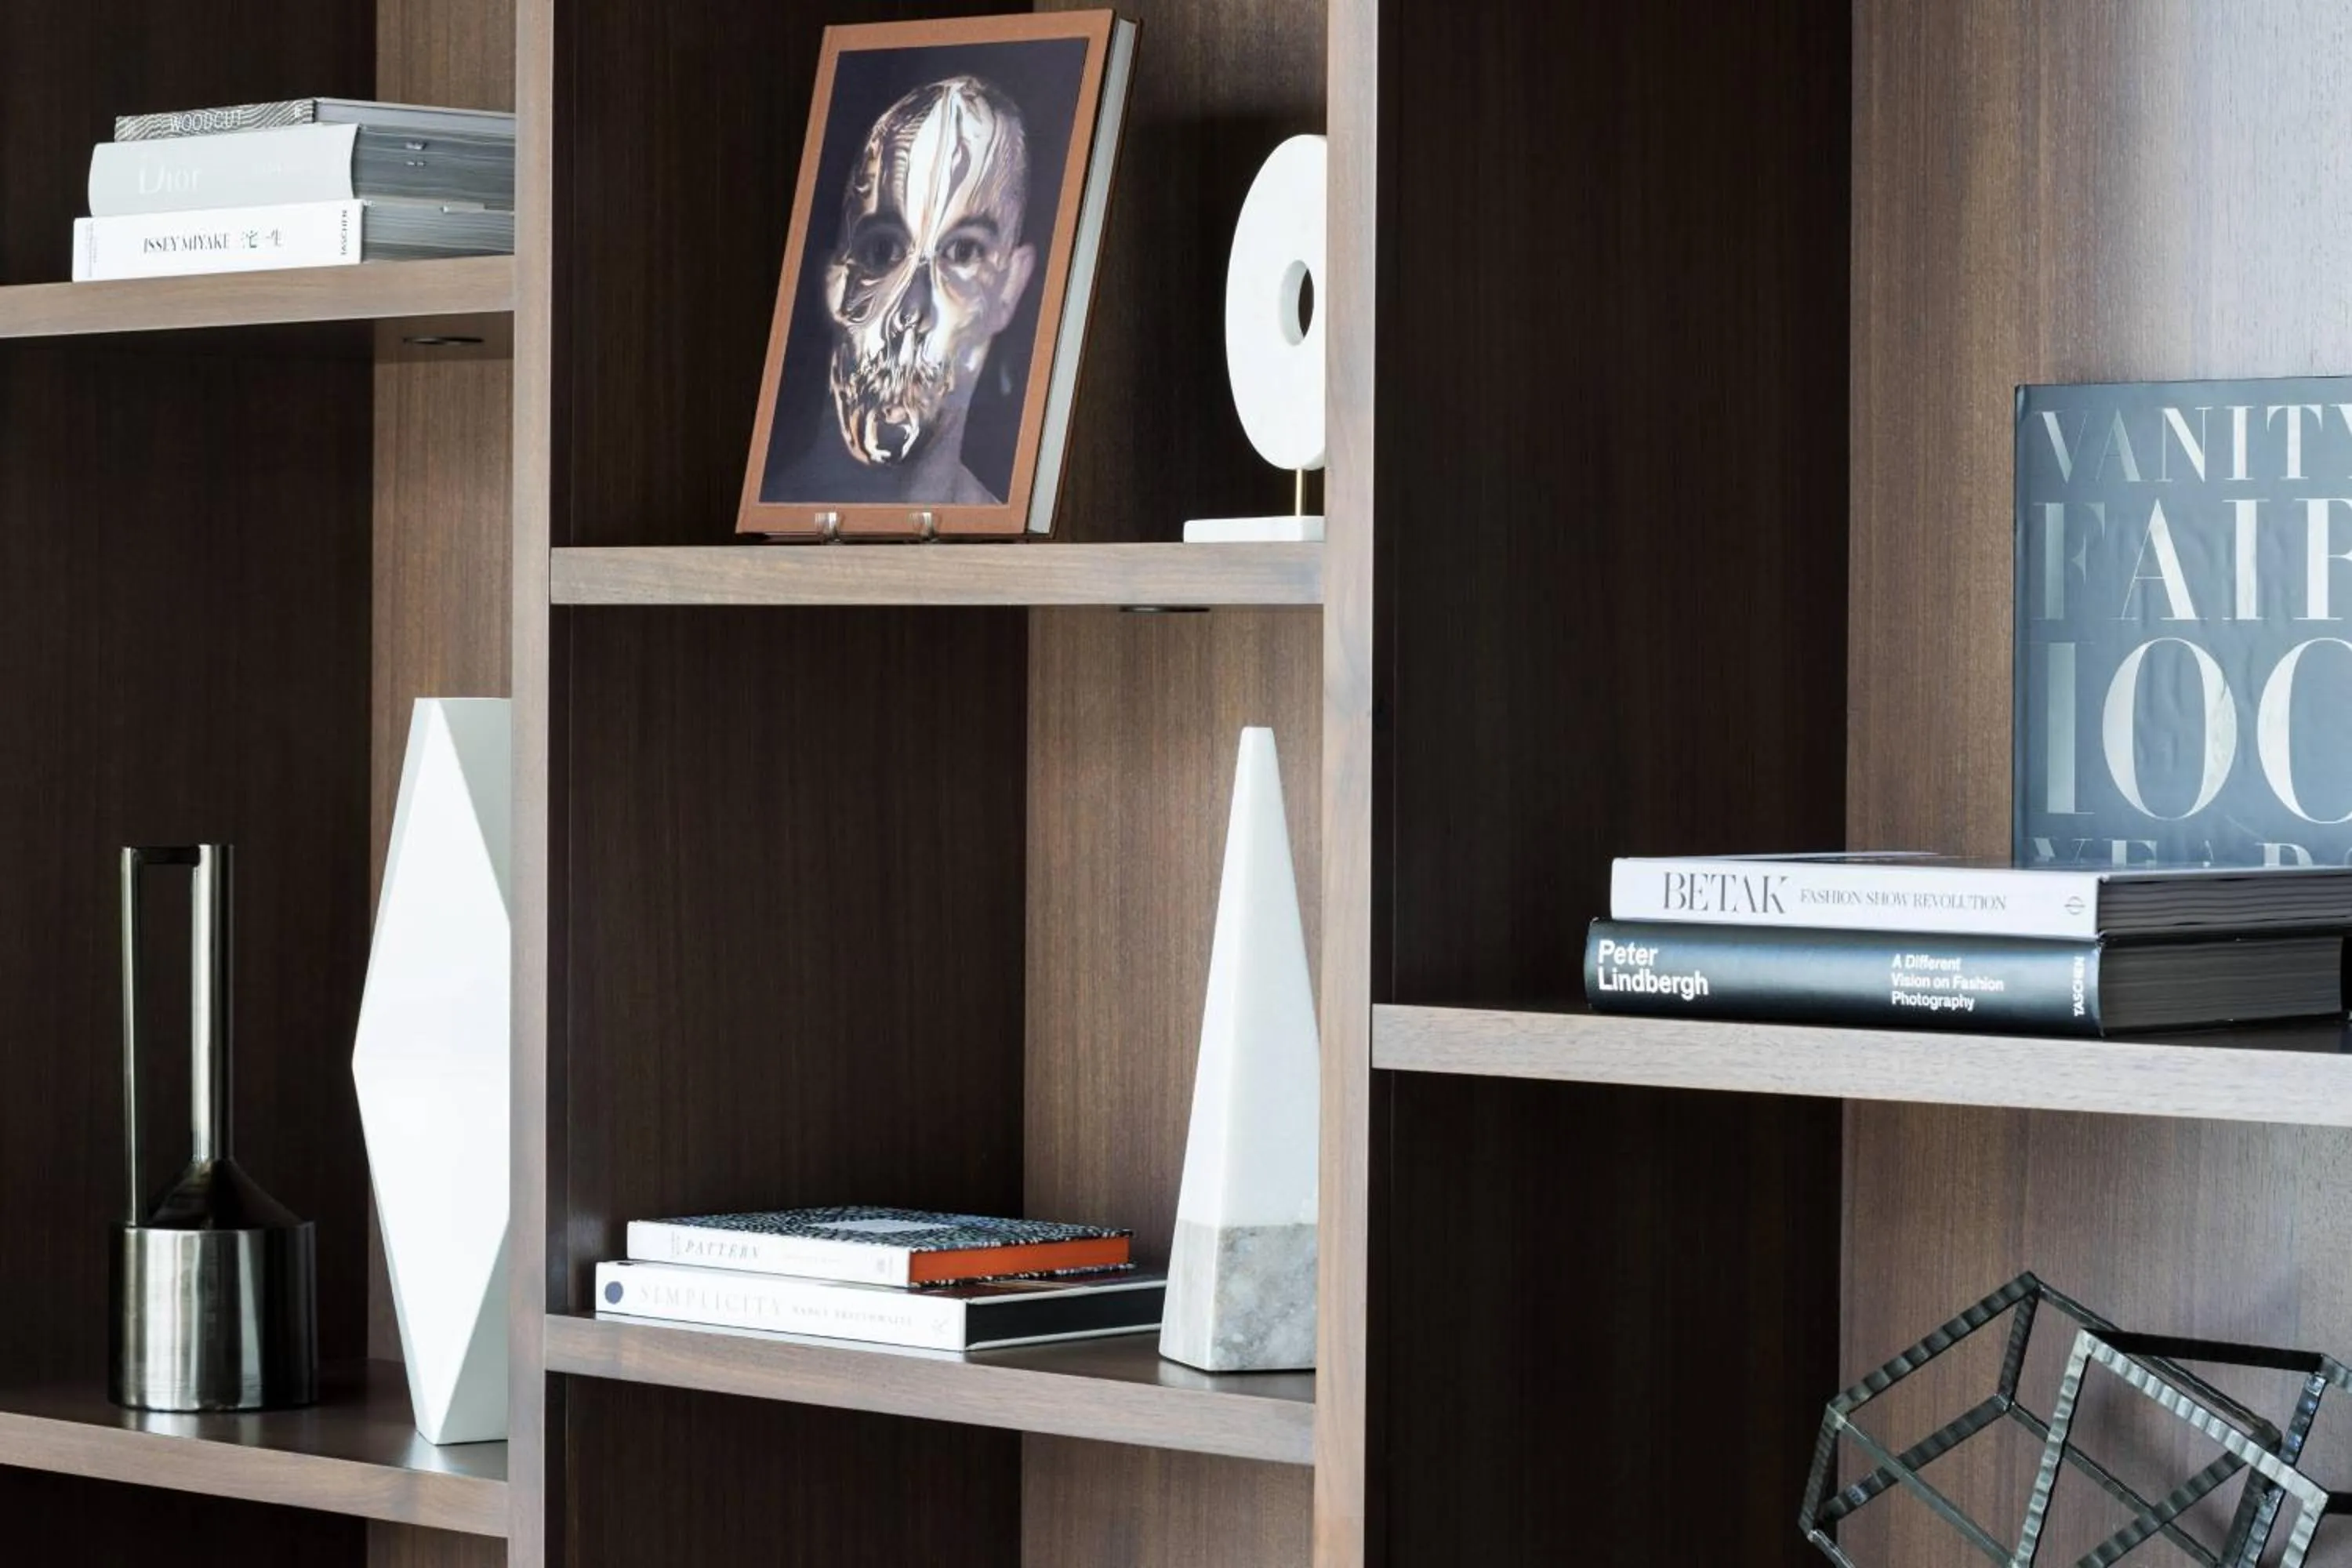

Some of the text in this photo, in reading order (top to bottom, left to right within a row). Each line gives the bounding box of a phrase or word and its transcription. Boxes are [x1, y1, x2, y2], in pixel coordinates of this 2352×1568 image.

[170, 110, 241, 132] WOODCUT
[138, 153, 202, 194] Dior
[143, 232, 230, 253] ISSEY MIYAKE
[1663, 871, 2007, 915] BETAK FASHION SHOW REVOLUTION
[1598, 940, 1658, 967] Peter
[1892, 953, 1962, 971] A Different
[1598, 967, 1708, 1001] Lindbergh
[1891, 972, 2005, 992] Vision on Fashion
[2072, 956, 2085, 1017] TASCHEN
[1891, 991, 1975, 1011] Photography
[684, 1238, 760, 1258] PATTERN
[640, 1283, 781, 1316] SIMPLICITY
